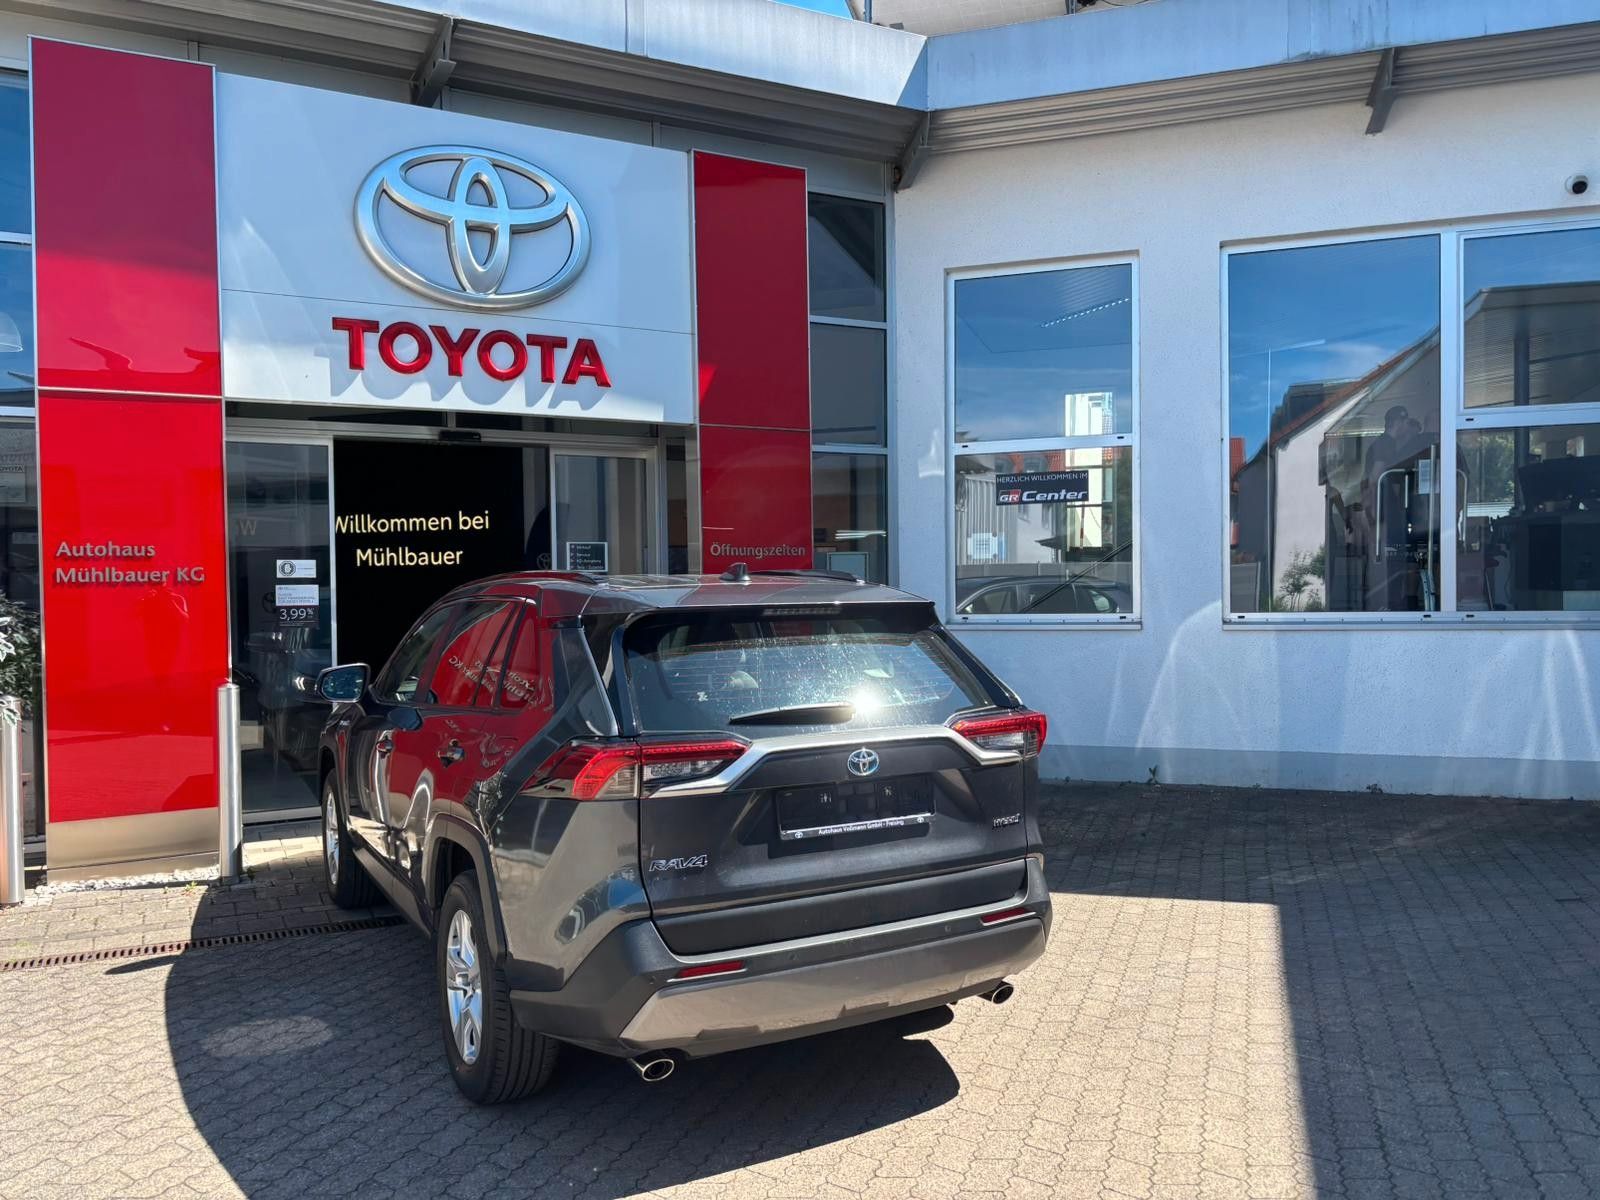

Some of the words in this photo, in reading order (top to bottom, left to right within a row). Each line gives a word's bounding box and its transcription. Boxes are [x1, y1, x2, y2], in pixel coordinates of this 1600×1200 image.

[332, 317, 611, 387] TOYOTA
[996, 475, 1030, 484] HERZLICH
[1031, 473, 1078, 481] WILLKOMMEN
[1080, 472, 1088, 480] IM
[1022, 489, 1087, 501] Center
[458, 510, 489, 530] bei
[56, 541, 156, 557] Autohaus
[356, 546, 464, 567] Mühlbauer
[710, 541, 806, 559] Öffnungszeiten
[56, 566, 170, 584] Mühlbauer
[177, 566, 205, 583] KG
[649, 854, 708, 872] RAV4
